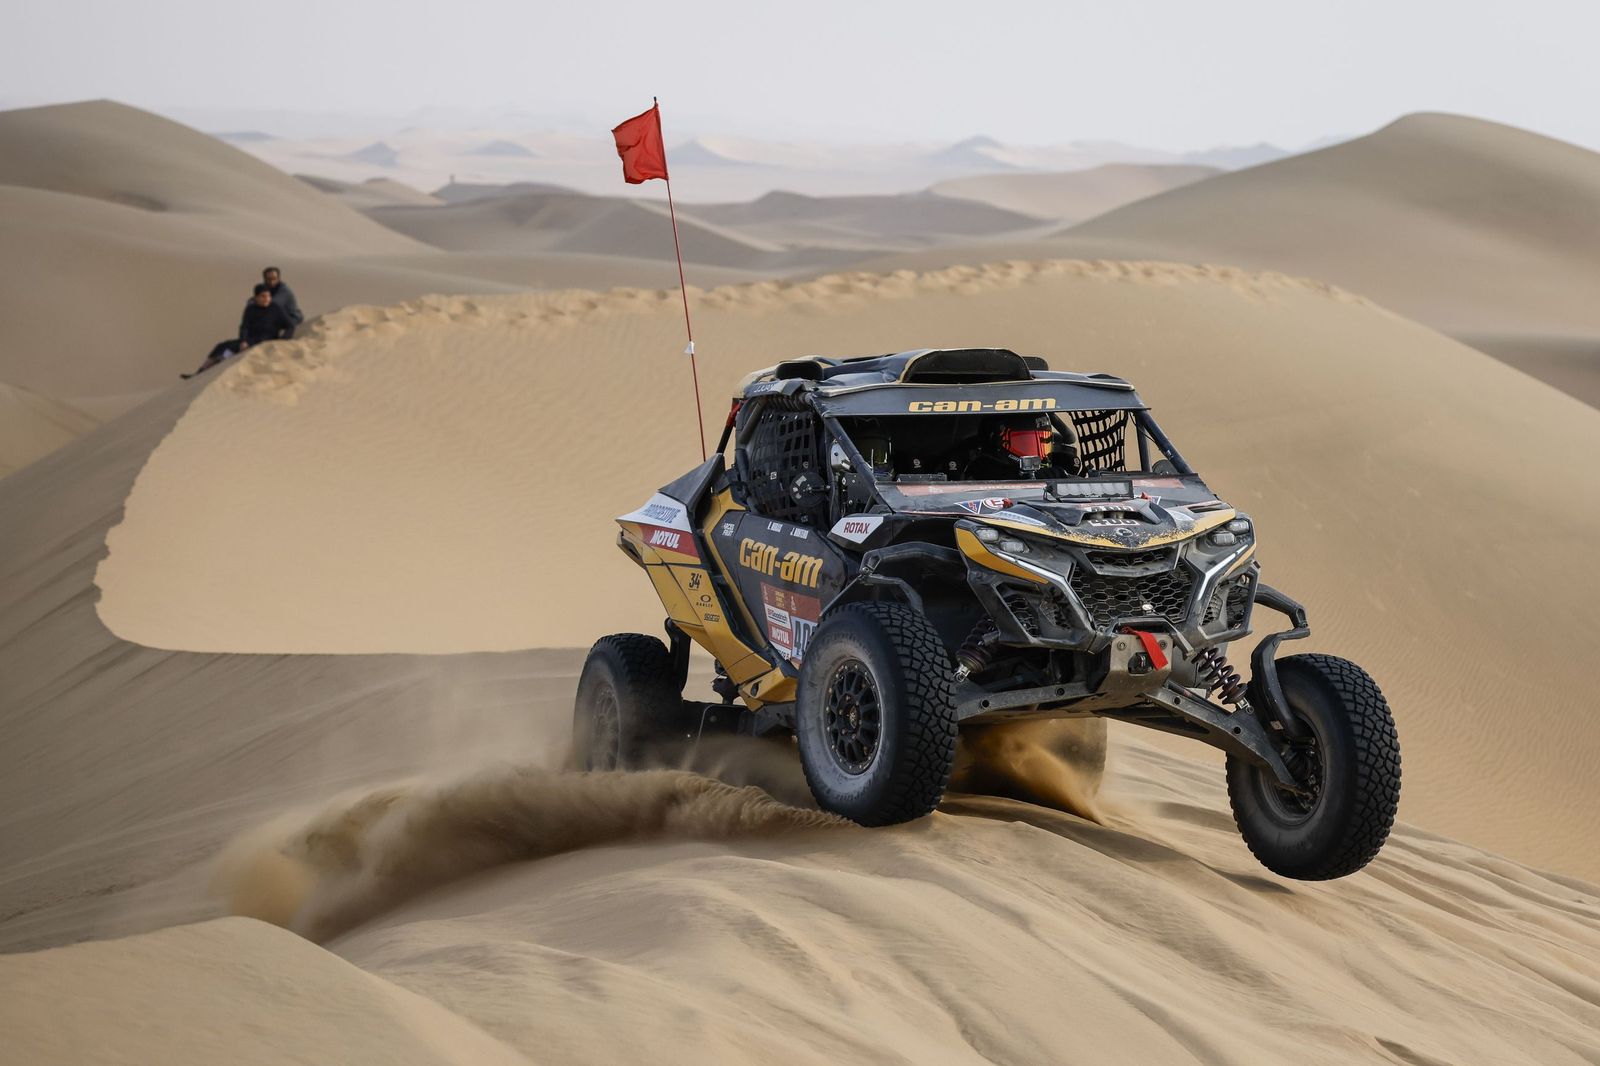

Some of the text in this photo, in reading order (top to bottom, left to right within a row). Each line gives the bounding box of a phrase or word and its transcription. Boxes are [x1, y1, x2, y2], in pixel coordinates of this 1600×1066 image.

[909, 398, 1056, 412] can-am
[844, 522, 870, 534] ROTAX
[650, 530, 680, 548] MOTUL
[739, 537, 824, 588] can-am
[771, 626, 790, 645] MOTUL
[794, 620, 818, 655] 40
